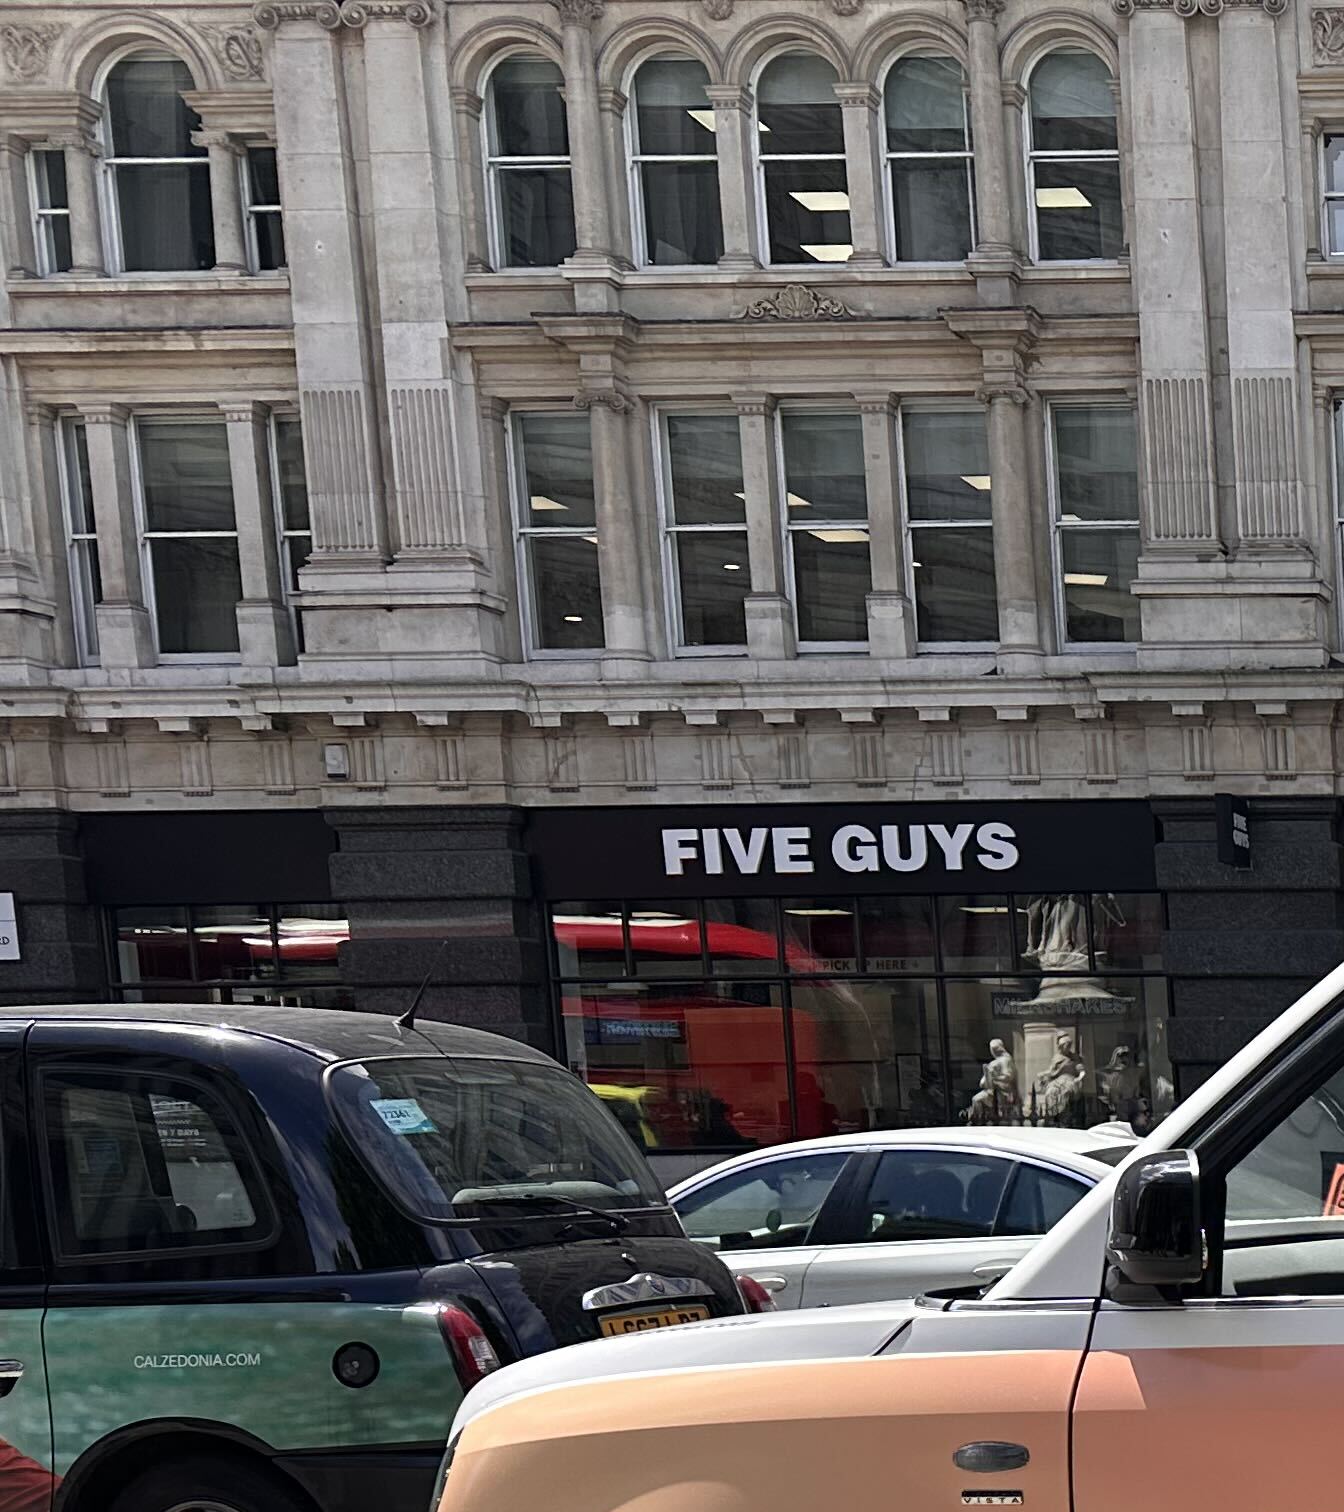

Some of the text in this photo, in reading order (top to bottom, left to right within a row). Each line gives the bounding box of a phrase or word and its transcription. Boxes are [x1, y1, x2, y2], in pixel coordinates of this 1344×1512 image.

[661, 821, 1020, 876] FIVE GUYS
[876, 959, 908, 971] HERE
[133, 1352, 261, 1369] CALZEDONIA.COM
[963, 1496, 1020, 1504] VISTA
